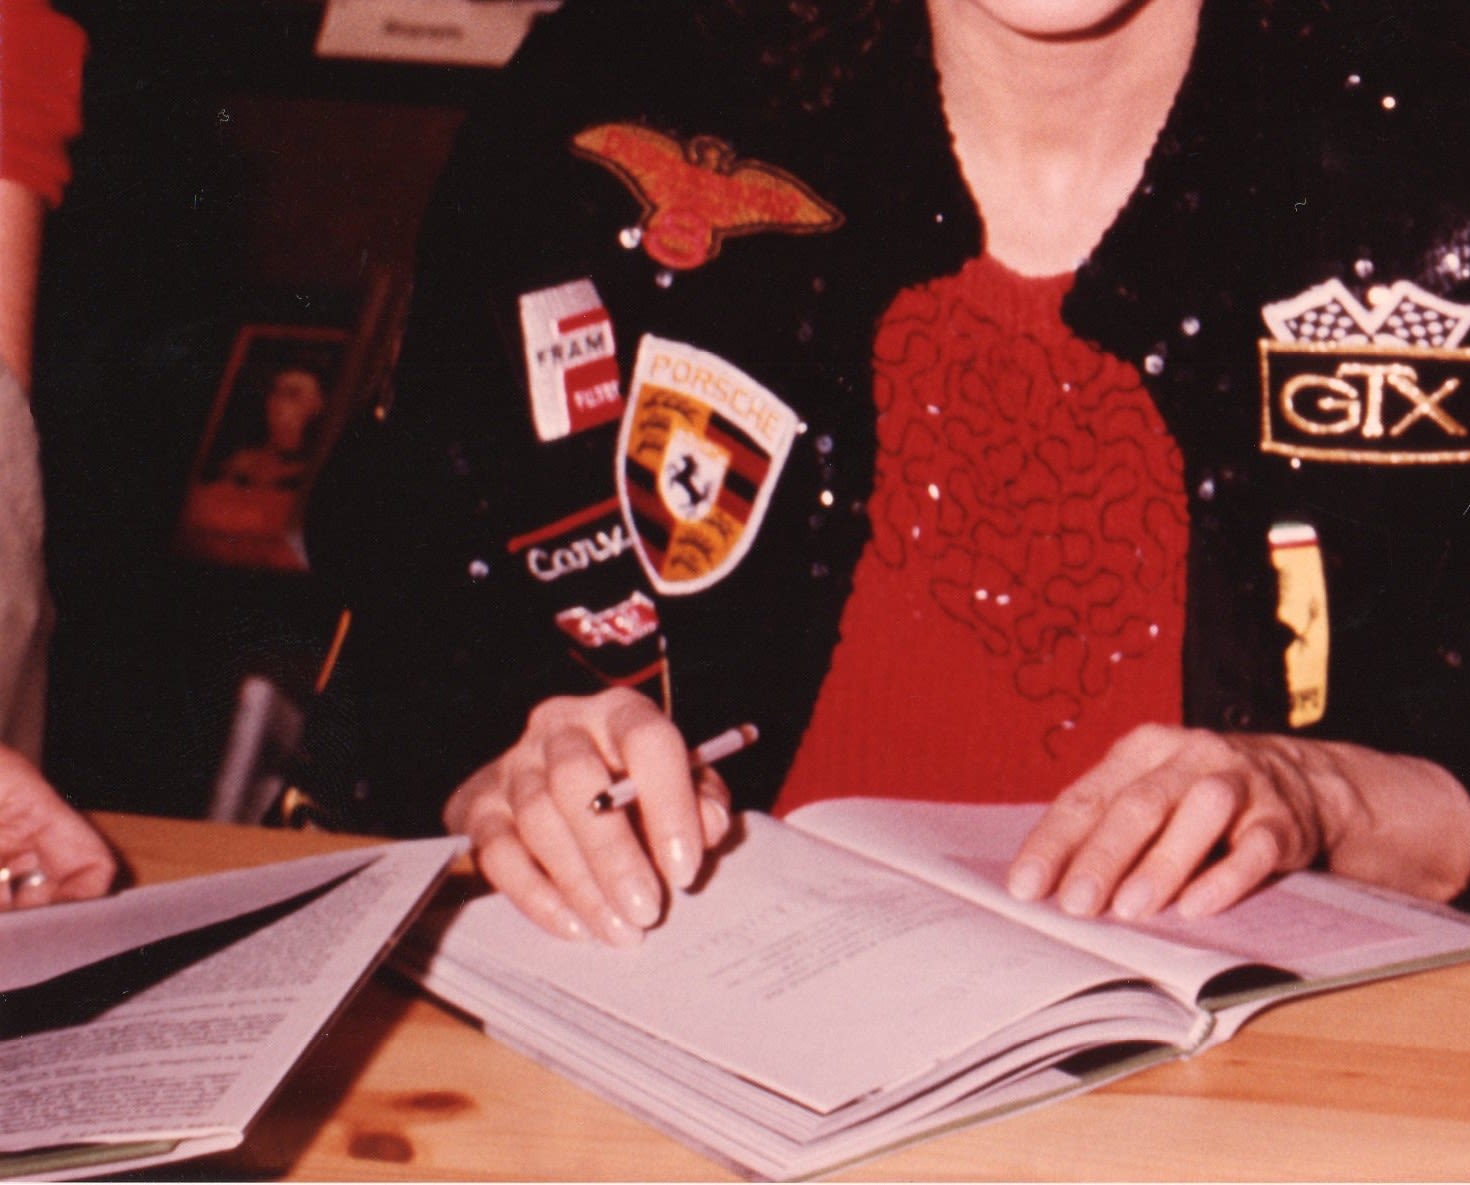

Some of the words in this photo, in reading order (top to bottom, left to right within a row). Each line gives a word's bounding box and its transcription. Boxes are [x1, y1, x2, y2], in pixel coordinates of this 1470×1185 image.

[535, 332, 606, 366] FRAM
[650, 354, 780, 442] PORSCHE
[1280, 361, 1468, 438] GTX
